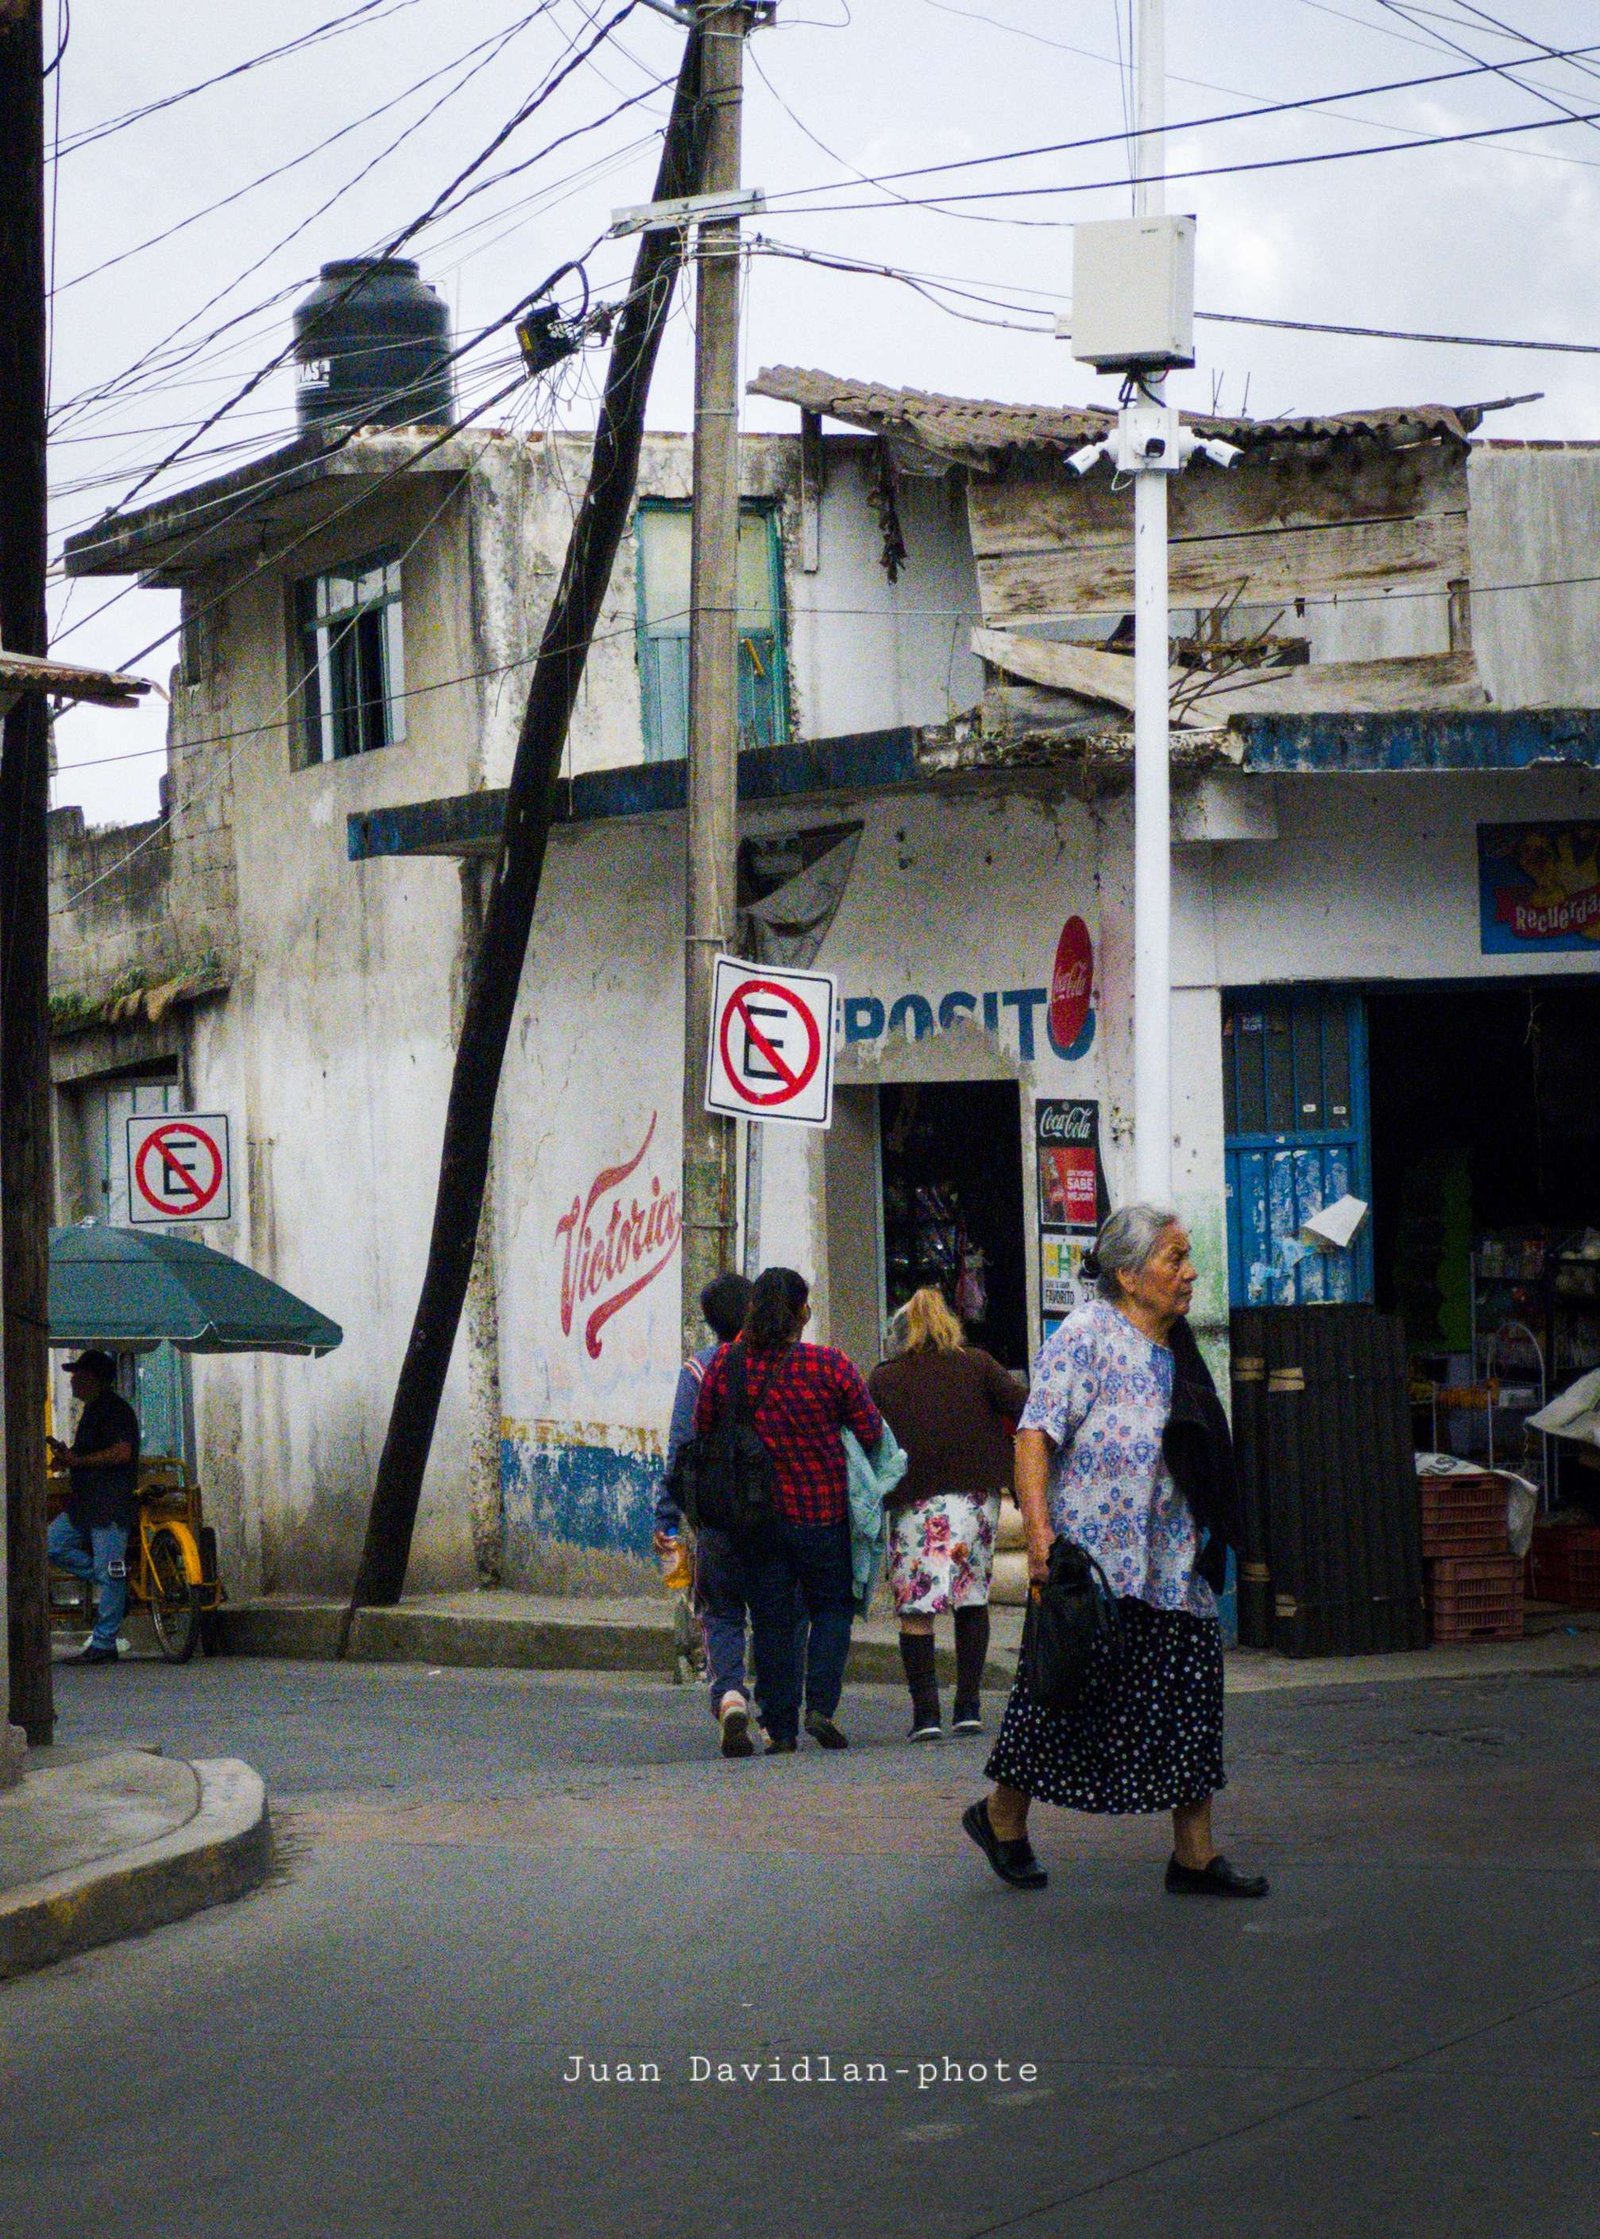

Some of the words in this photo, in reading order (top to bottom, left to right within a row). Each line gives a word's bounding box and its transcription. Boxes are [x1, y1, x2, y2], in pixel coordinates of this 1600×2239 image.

[743, 1004, 788, 1080] E
[163, 1141, 197, 1195] E
[553, 1110, 682, 1337] Victoria
